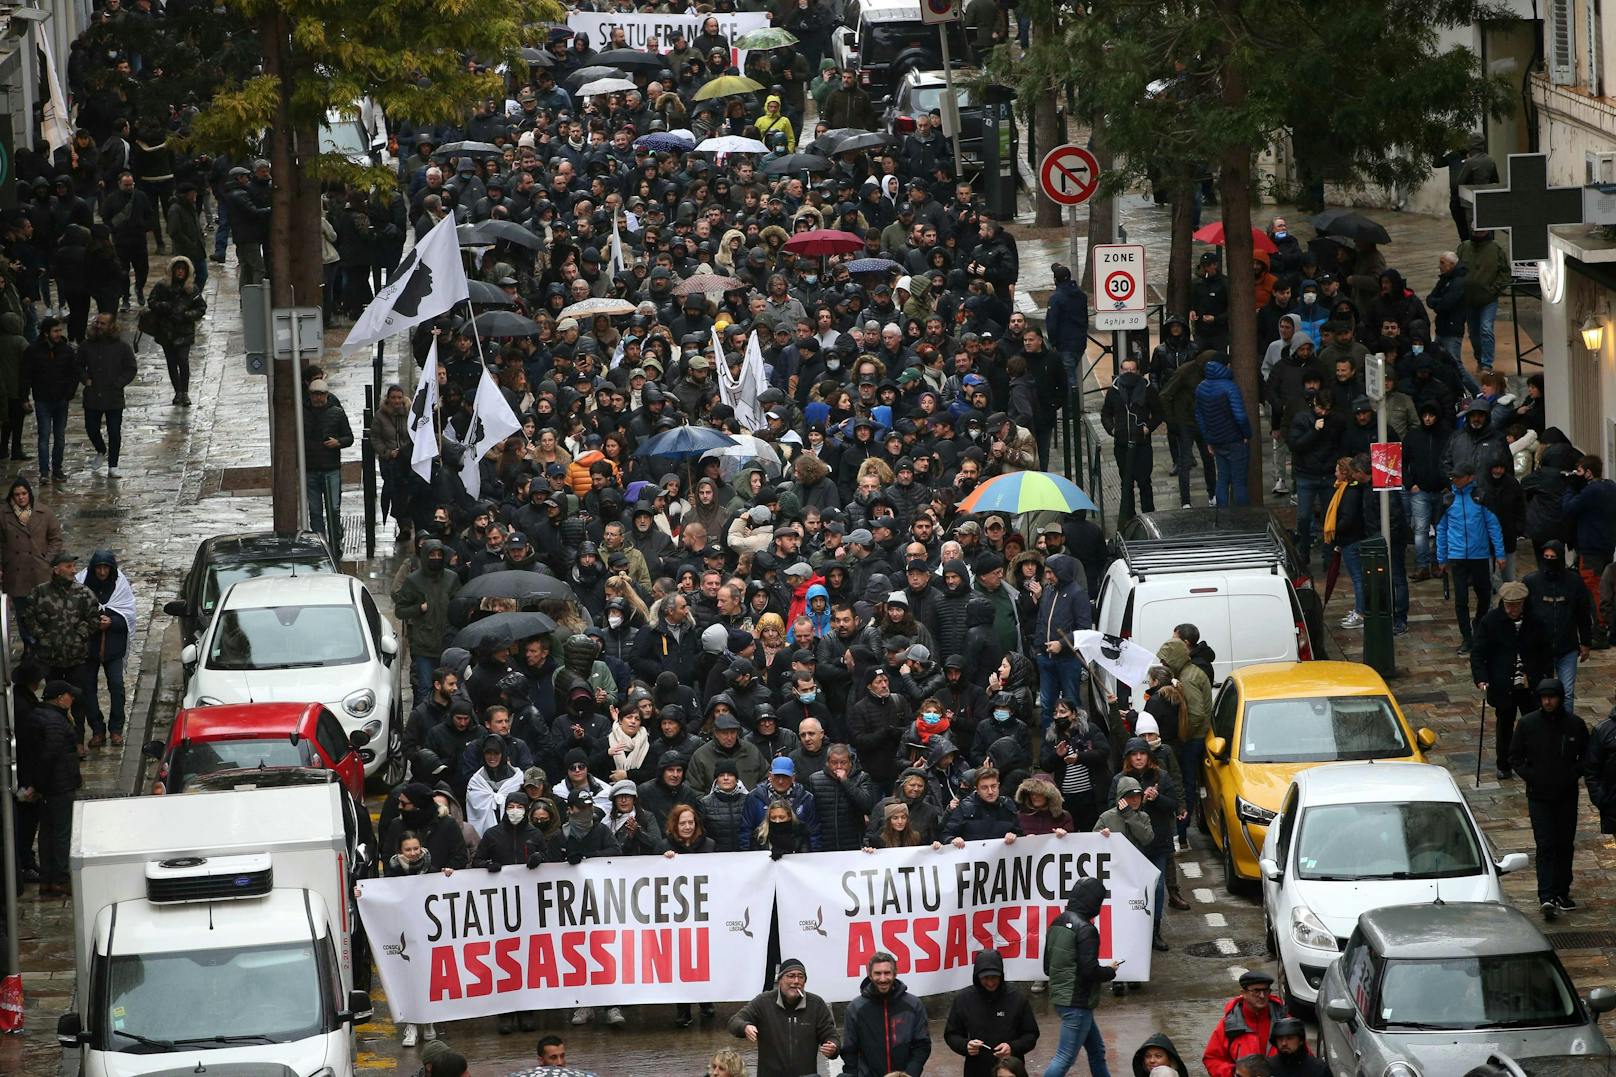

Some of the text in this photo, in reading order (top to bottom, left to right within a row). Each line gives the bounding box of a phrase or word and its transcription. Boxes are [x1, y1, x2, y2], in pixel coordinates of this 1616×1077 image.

[1104, 253, 1135, 263] ZONE
[1111, 279, 1130, 293] 30
[424, 875, 709, 942] STATU FRANCESE
[841, 865, 941, 917] STATU
[429, 927, 711, 1002] ASSASSINU
